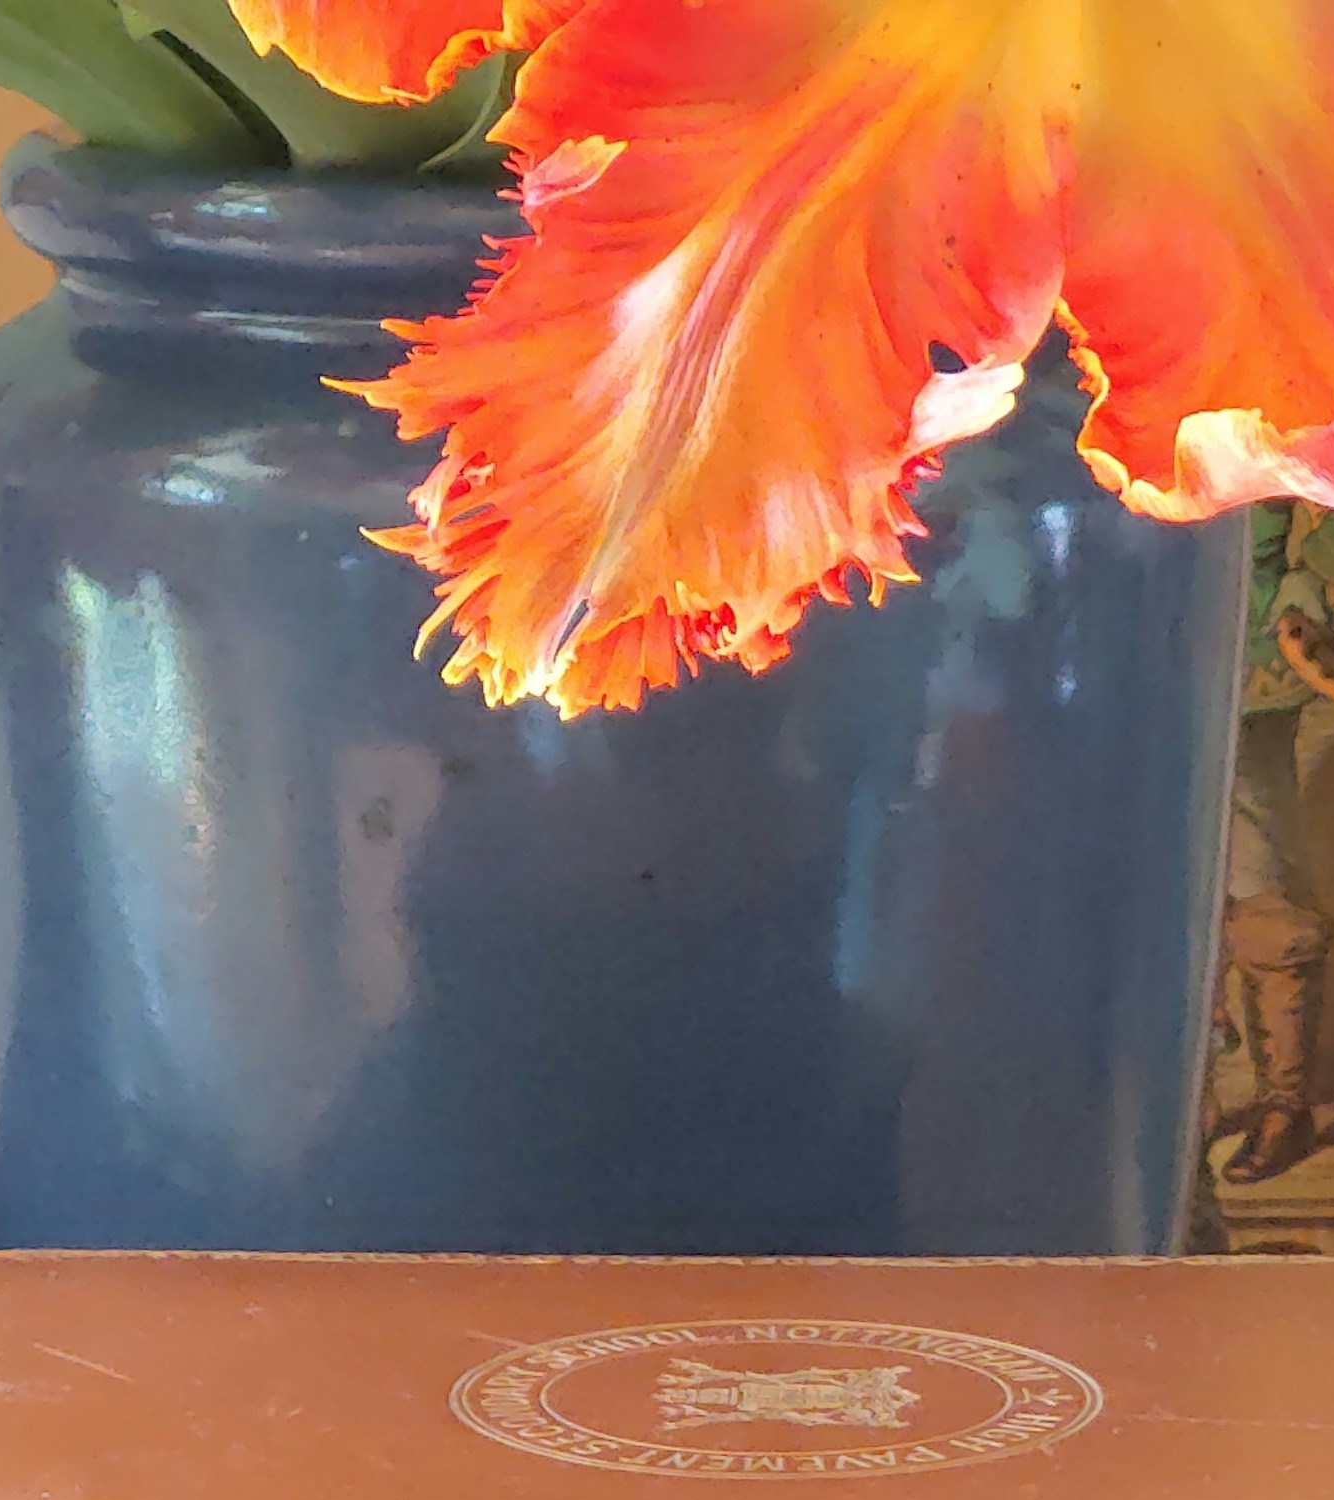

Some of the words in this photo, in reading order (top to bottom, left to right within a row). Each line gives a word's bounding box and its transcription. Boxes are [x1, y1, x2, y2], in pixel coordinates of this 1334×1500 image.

[524, 1327, 701, 1370] SCHOOL
[742, 1324, 1061, 1382] NOTTINGHAM
[479, 1366, 620, 1455] SECONDARY
[949, 1412, 1064, 1453] HIGH
[617, 1446, 947, 1473] PAVEMENT
